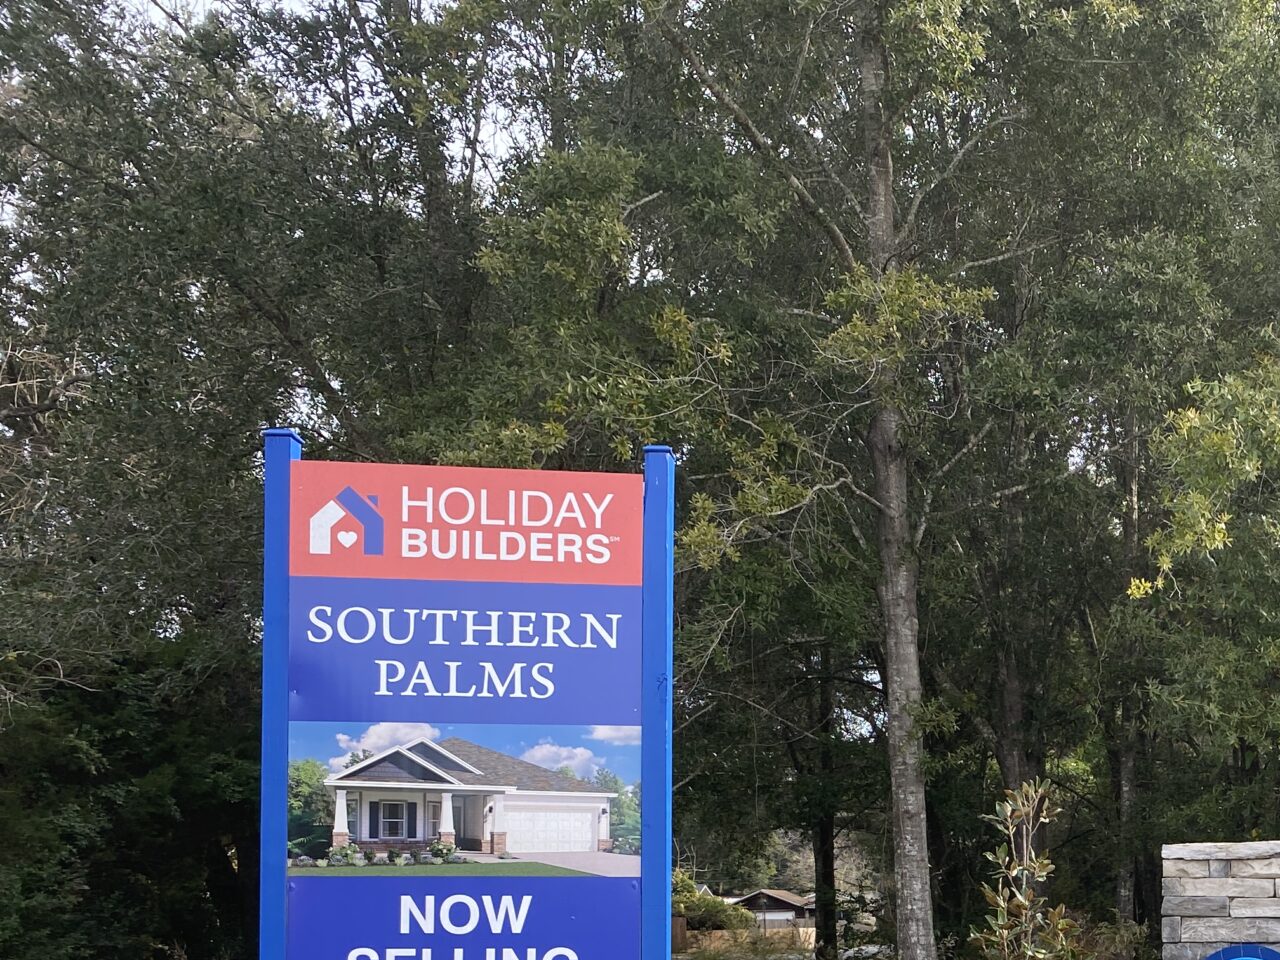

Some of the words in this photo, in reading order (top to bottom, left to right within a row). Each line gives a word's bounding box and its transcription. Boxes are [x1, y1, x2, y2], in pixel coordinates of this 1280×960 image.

[401, 486, 614, 529] HOLIDAY
[401, 528, 611, 564] BUILDERS
[306, 606, 622, 649] SOUTHERN
[374, 660, 555, 699] PALMS
[400, 895, 532, 935] NOW
